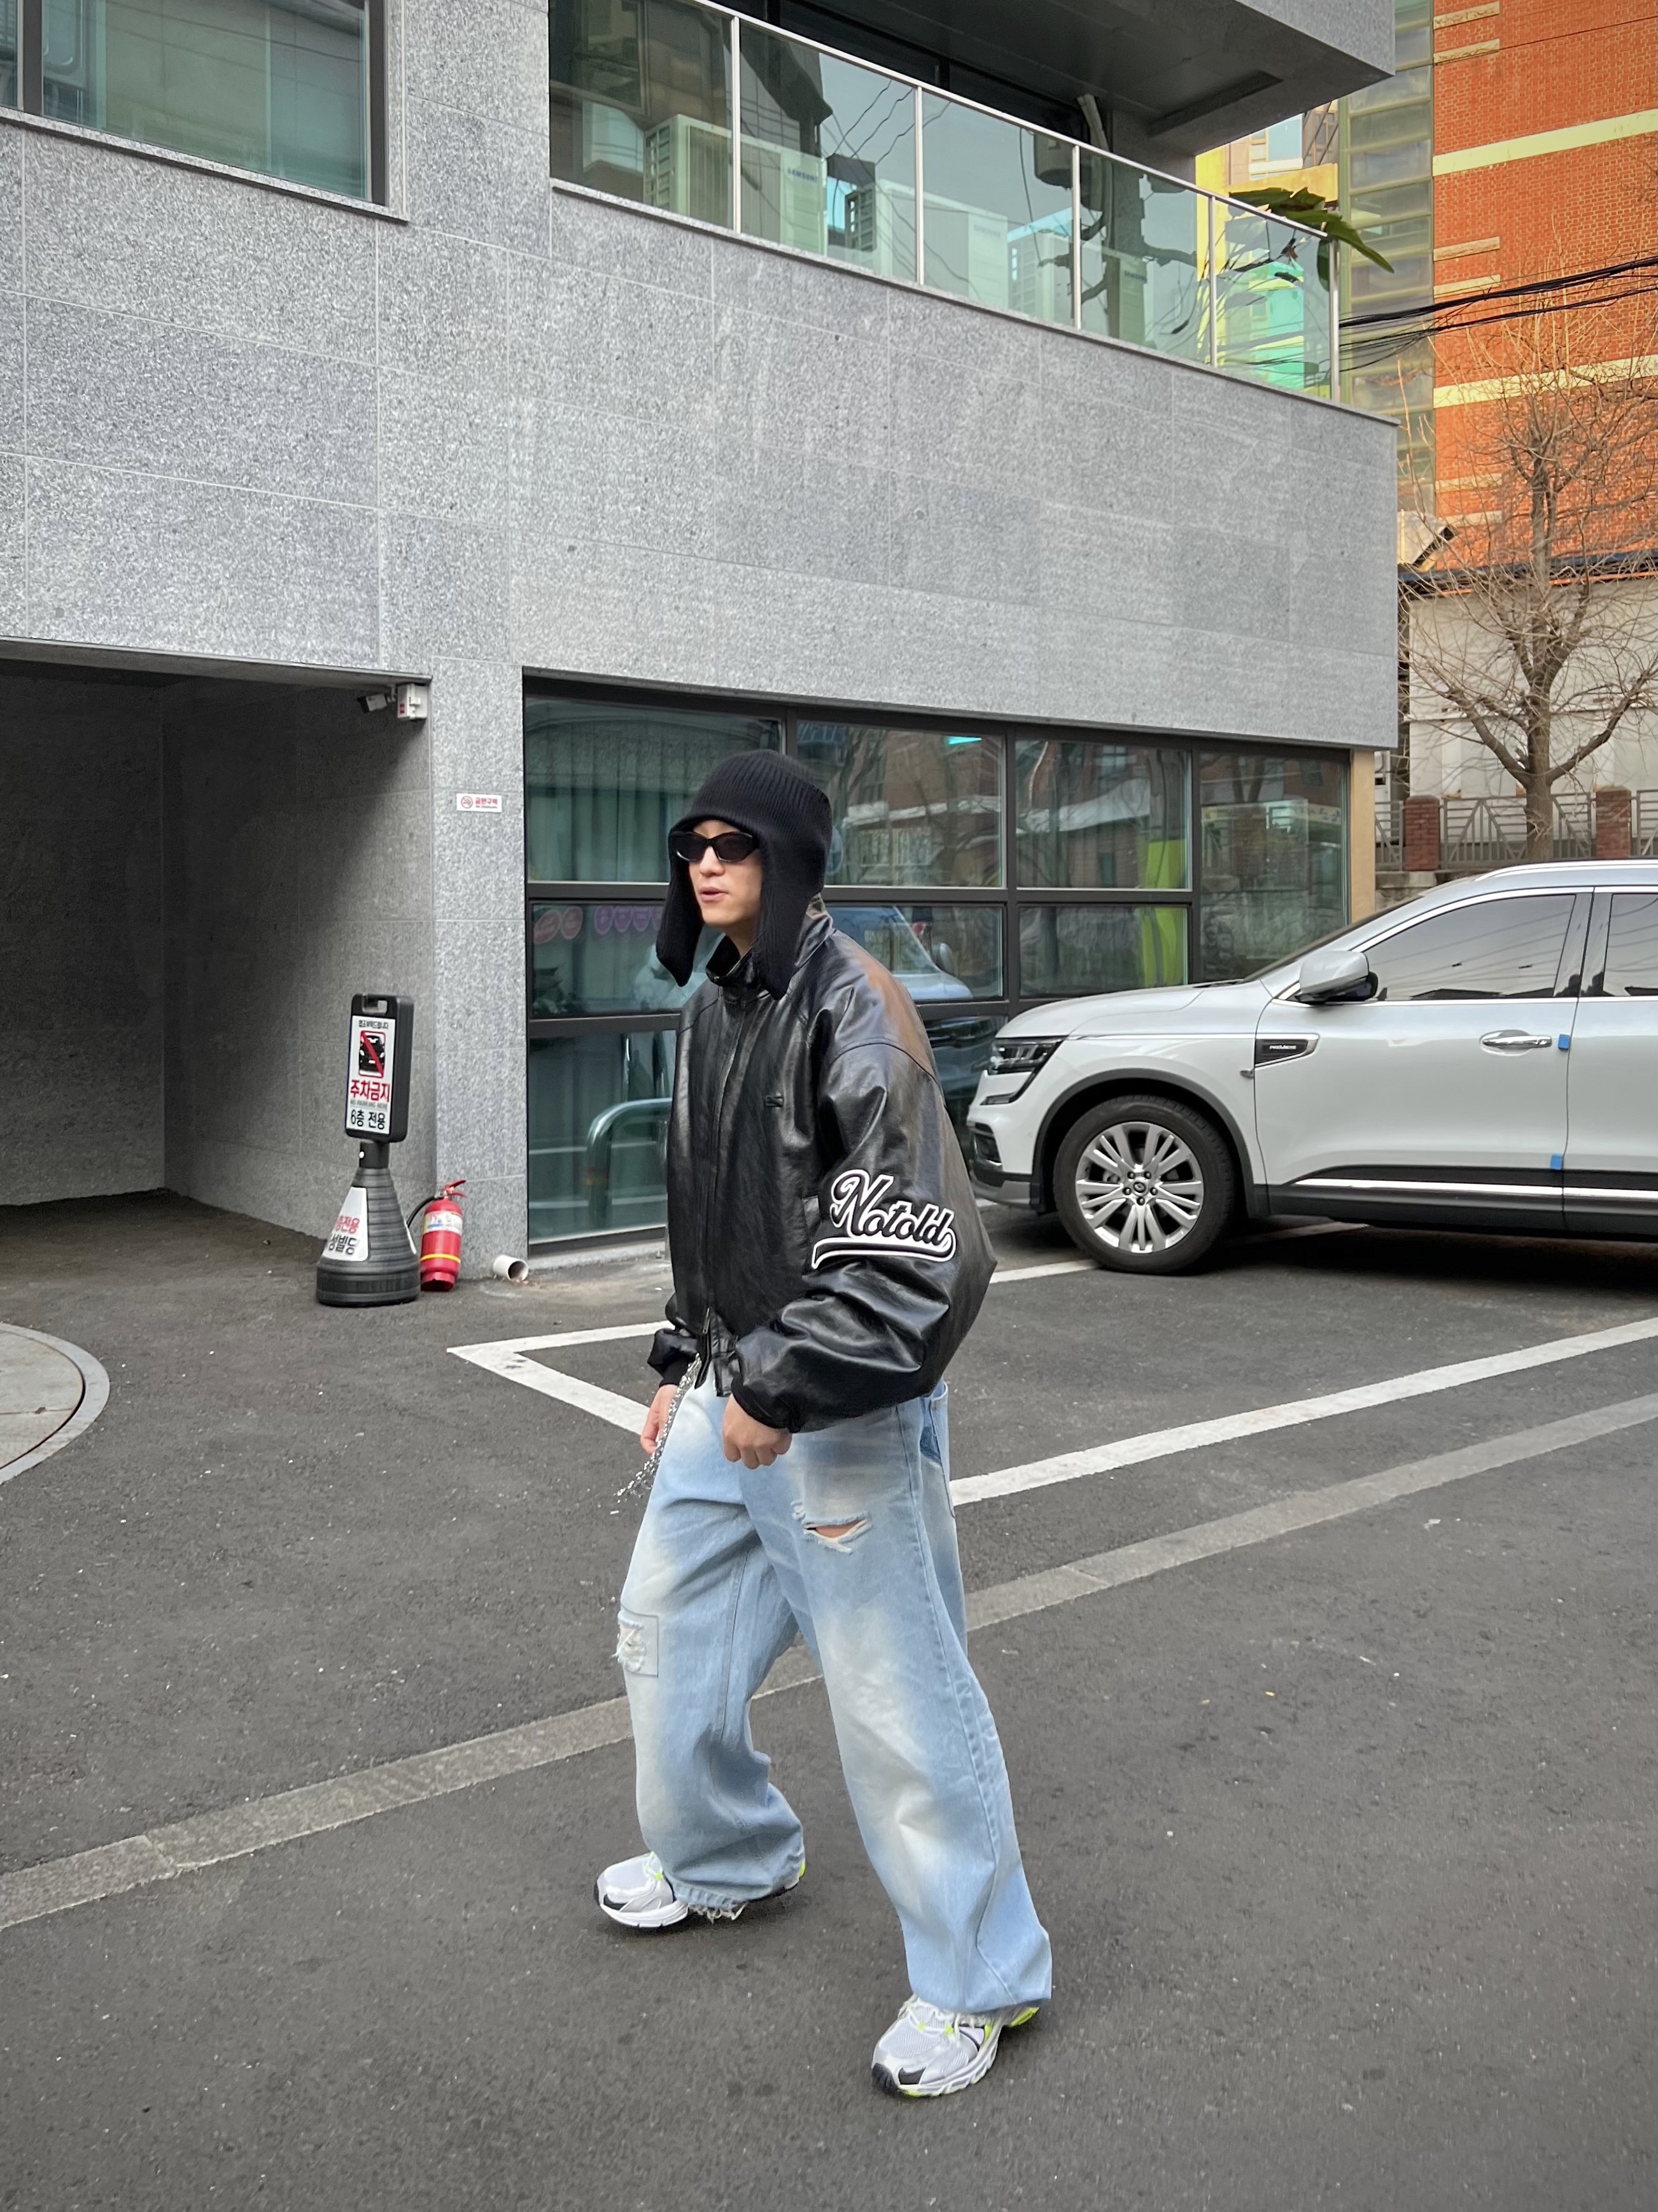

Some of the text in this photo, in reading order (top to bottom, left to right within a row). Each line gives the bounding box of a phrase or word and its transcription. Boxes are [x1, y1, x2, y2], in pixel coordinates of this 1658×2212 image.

[350, 1079, 391, 1102] 주차금지
[351, 1109, 386, 1130] 6층 전용
[830, 1169, 955, 1248] Notold
